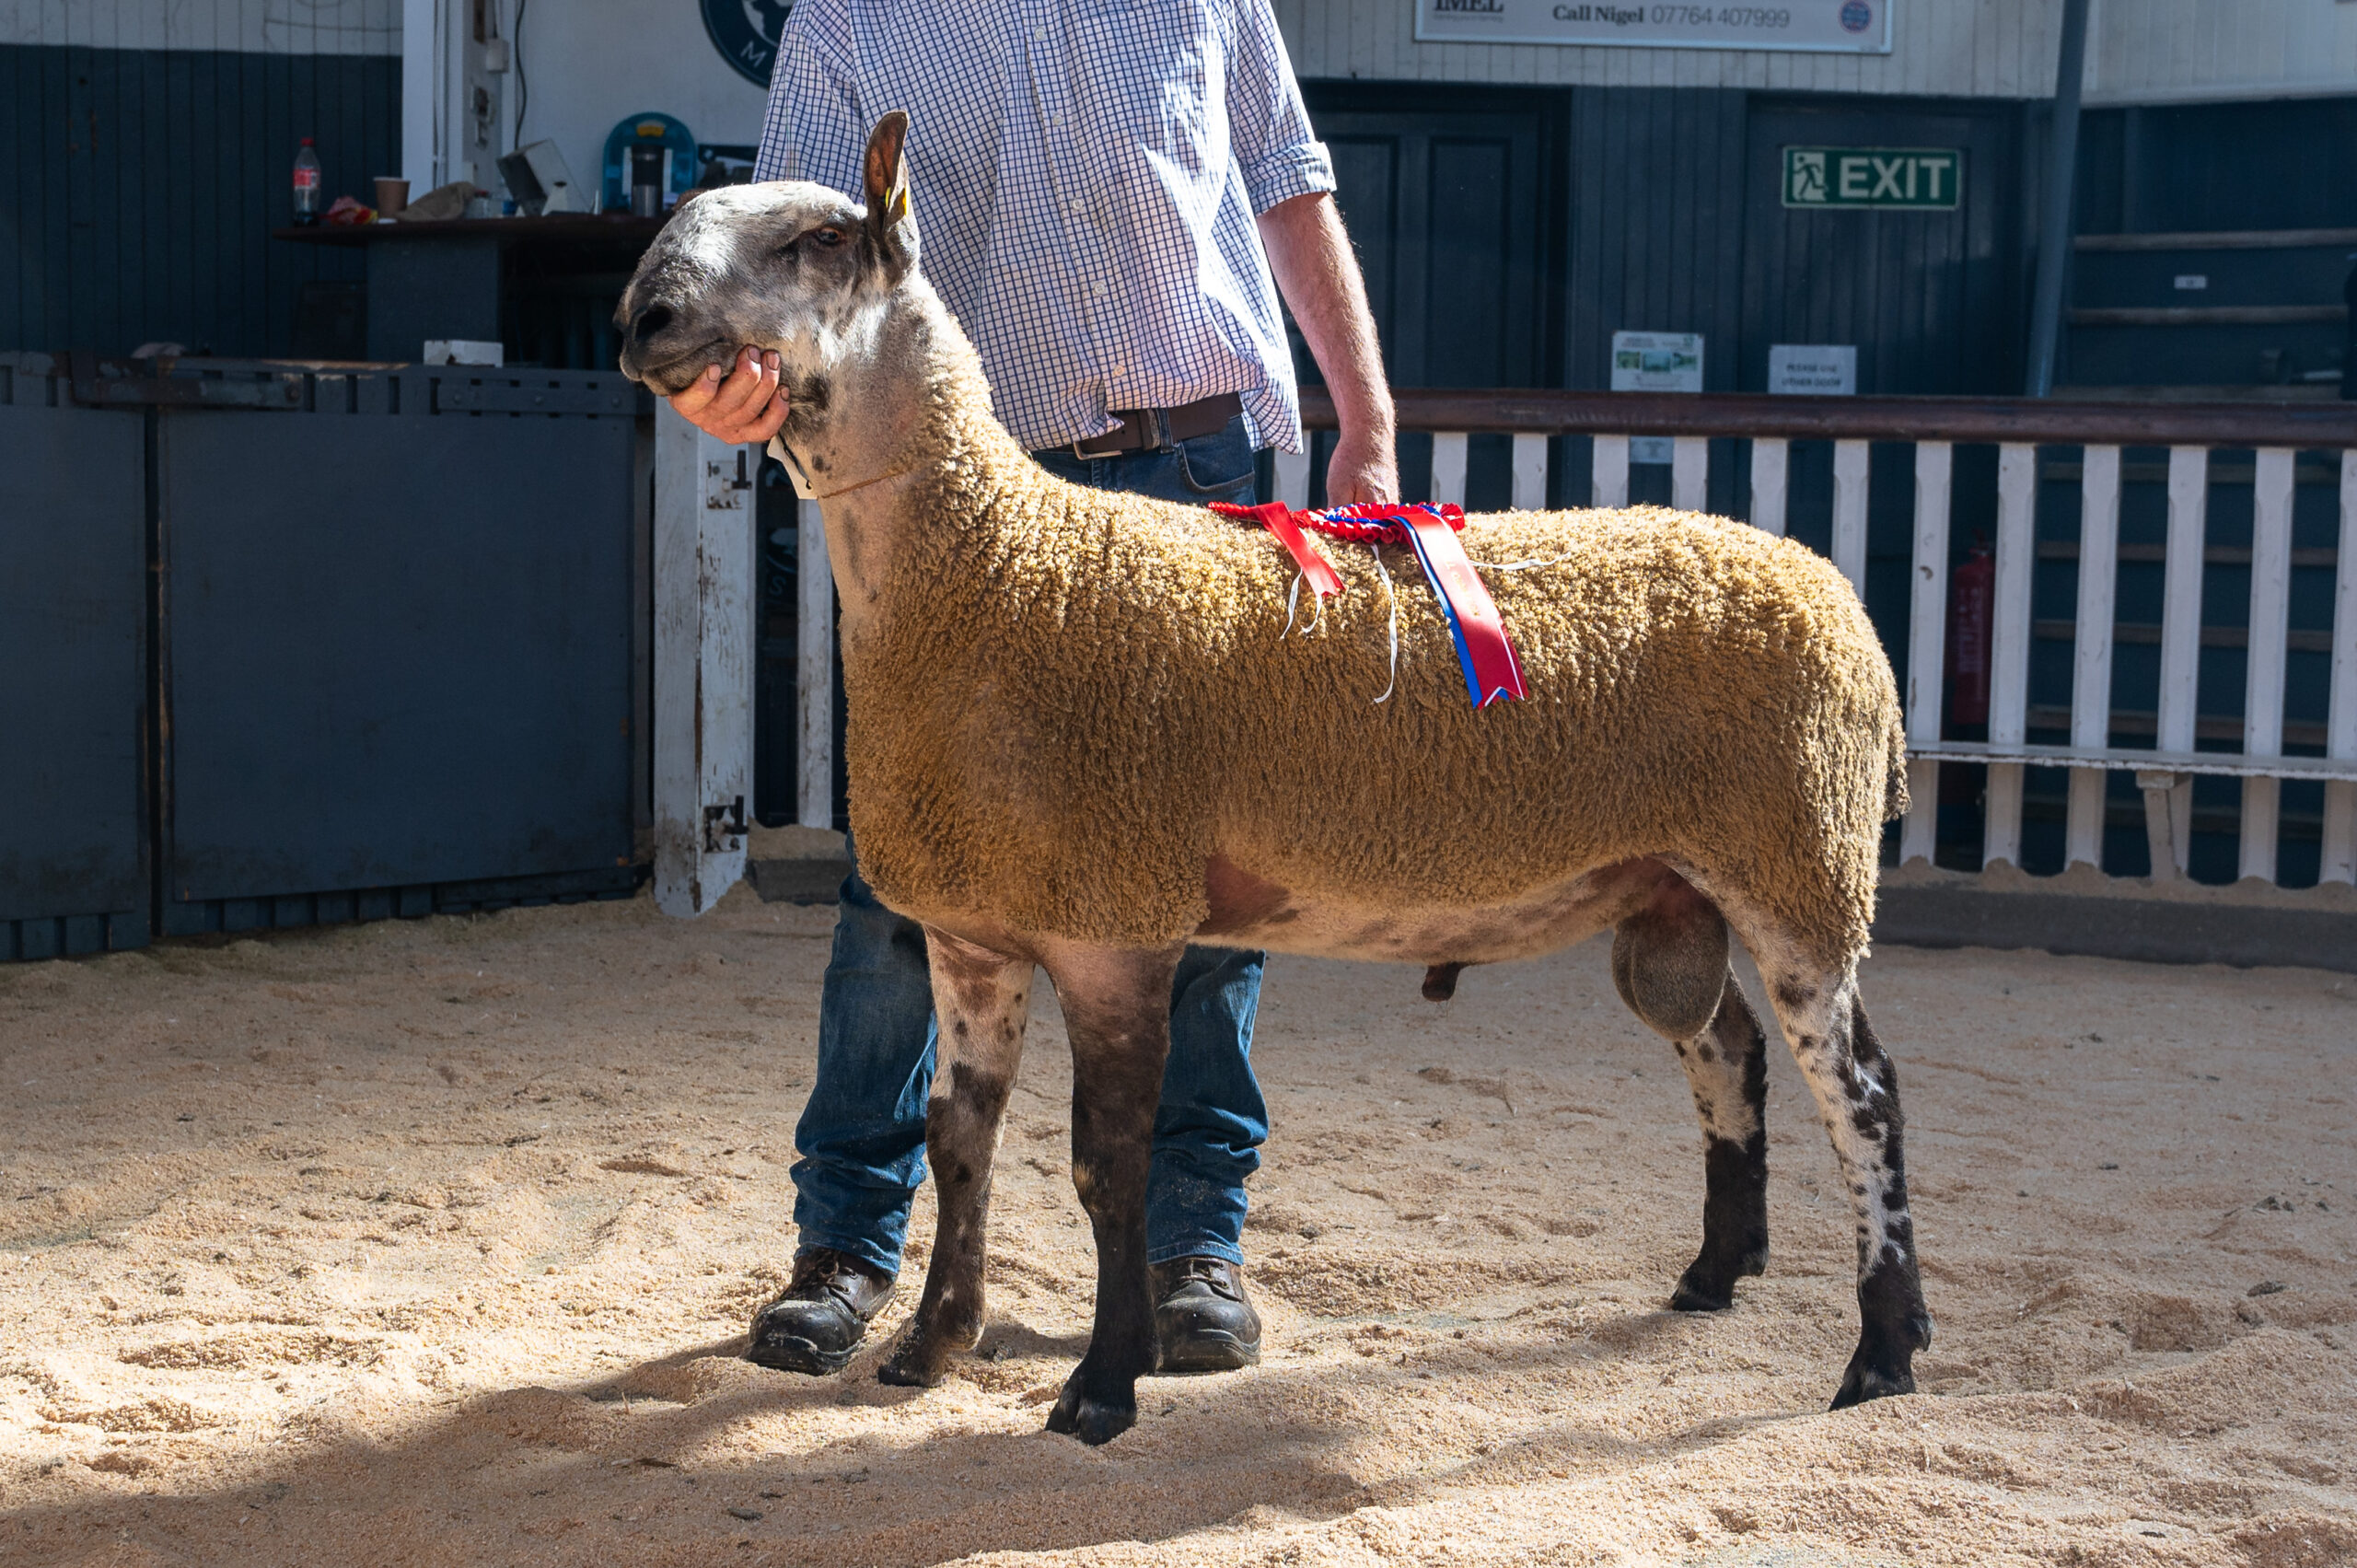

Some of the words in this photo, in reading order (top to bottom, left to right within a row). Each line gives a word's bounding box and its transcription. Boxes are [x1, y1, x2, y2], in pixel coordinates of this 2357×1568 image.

[1552, 5, 1591, 22] Call
[1596, 6, 1644, 26] Nigel
[1650, 6, 1713, 25] 07764
[1717, 7, 1791, 29] 407999
[1839, 157, 1952, 200] EXIT
